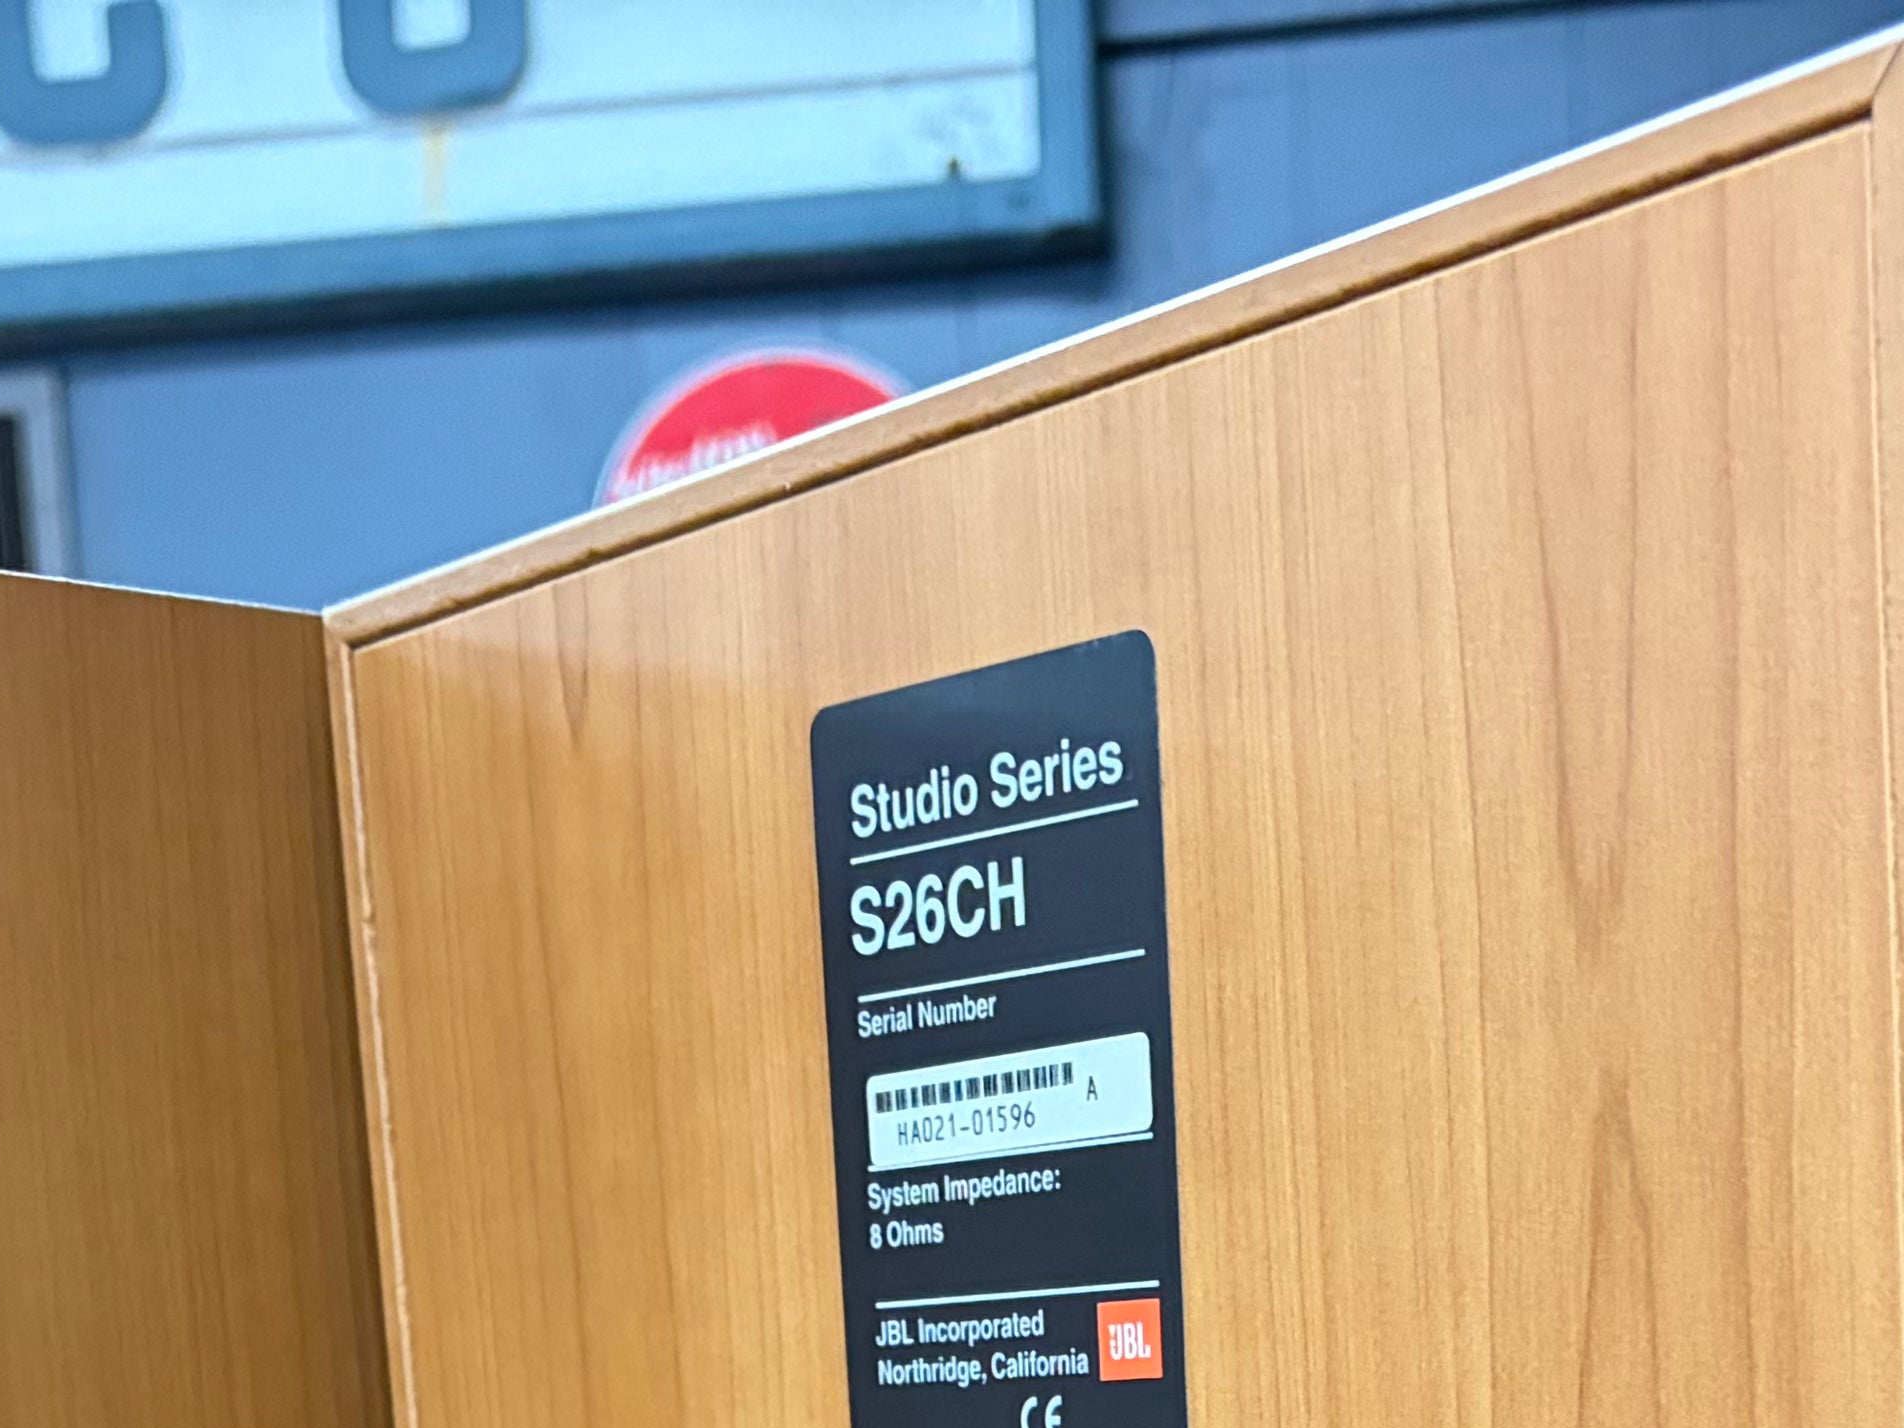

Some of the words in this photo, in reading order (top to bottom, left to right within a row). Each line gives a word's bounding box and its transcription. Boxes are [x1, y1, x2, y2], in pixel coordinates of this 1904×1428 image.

[851, 764, 978, 838] Studio
[990, 737, 1124, 808] Series
[850, 856, 1026, 956] S26CH
[858, 1003, 913, 1038] Serial
[918, 995, 997, 1029] Number
[1086, 1075, 1098, 1101] A
[897, 1101, 1036, 1146] HA021-01596
[867, 1179, 940, 1214] System
[944, 1168, 1061, 1206] Impedance:
[869, 1223, 882, 1249] 8
[886, 1220, 944, 1248] Ohms
[875, 1319, 914, 1347] JBL
[917, 1308, 1045, 1347] Incorporated
[1107, 1321, 1152, 1361] JBL
[877, 1355, 987, 1388] Northridge,
[990, 1348, 1090, 1381] California
